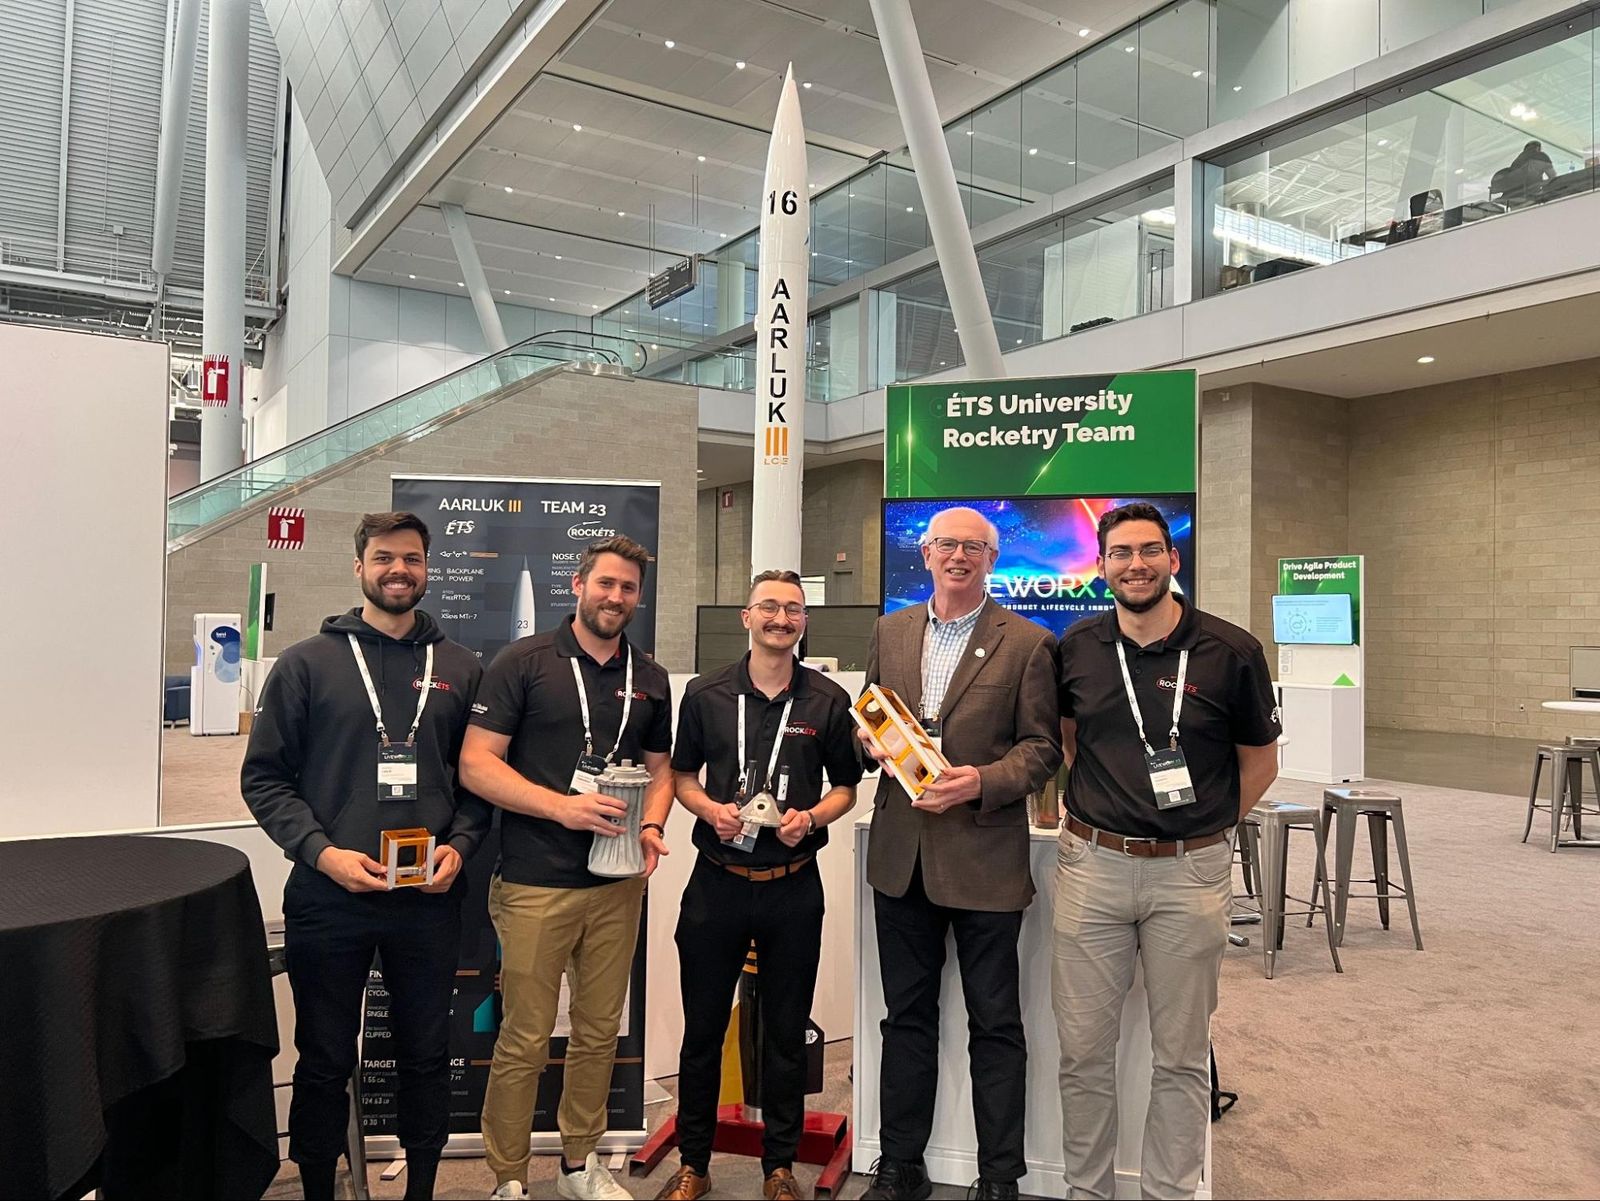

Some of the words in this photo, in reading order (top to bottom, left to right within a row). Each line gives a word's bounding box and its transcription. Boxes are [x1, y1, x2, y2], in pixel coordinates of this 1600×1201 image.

[767, 190, 797, 215] 16
[768, 278, 791, 423] AARLUK
[947, 392, 993, 417] ÉTS
[999, 389, 1133, 416] University
[943, 425, 1058, 450] Rocketry
[1061, 422, 1136, 444] Team
[438, 498, 505, 512] AARLUK
[541, 501, 585, 514] TEAM
[588, 504, 607, 516] 23
[446, 567, 485, 575] BACKPLANE
[1283, 562, 1303, 571] Drive
[1303, 561, 1323, 572] Agile
[1324, 560, 1357, 570] Product
[1293, 571, 1345, 581] Development
[985, 574, 1098, 599] EWORX
[1041, 603, 1085, 611] LIFECYCLE
[517, 620, 529, 629] 23
[366, 1010, 389, 1018] SINGLE
[365, 1031, 392, 1039] CLIPPED
[362, 1060, 396, 1068] TARGET
